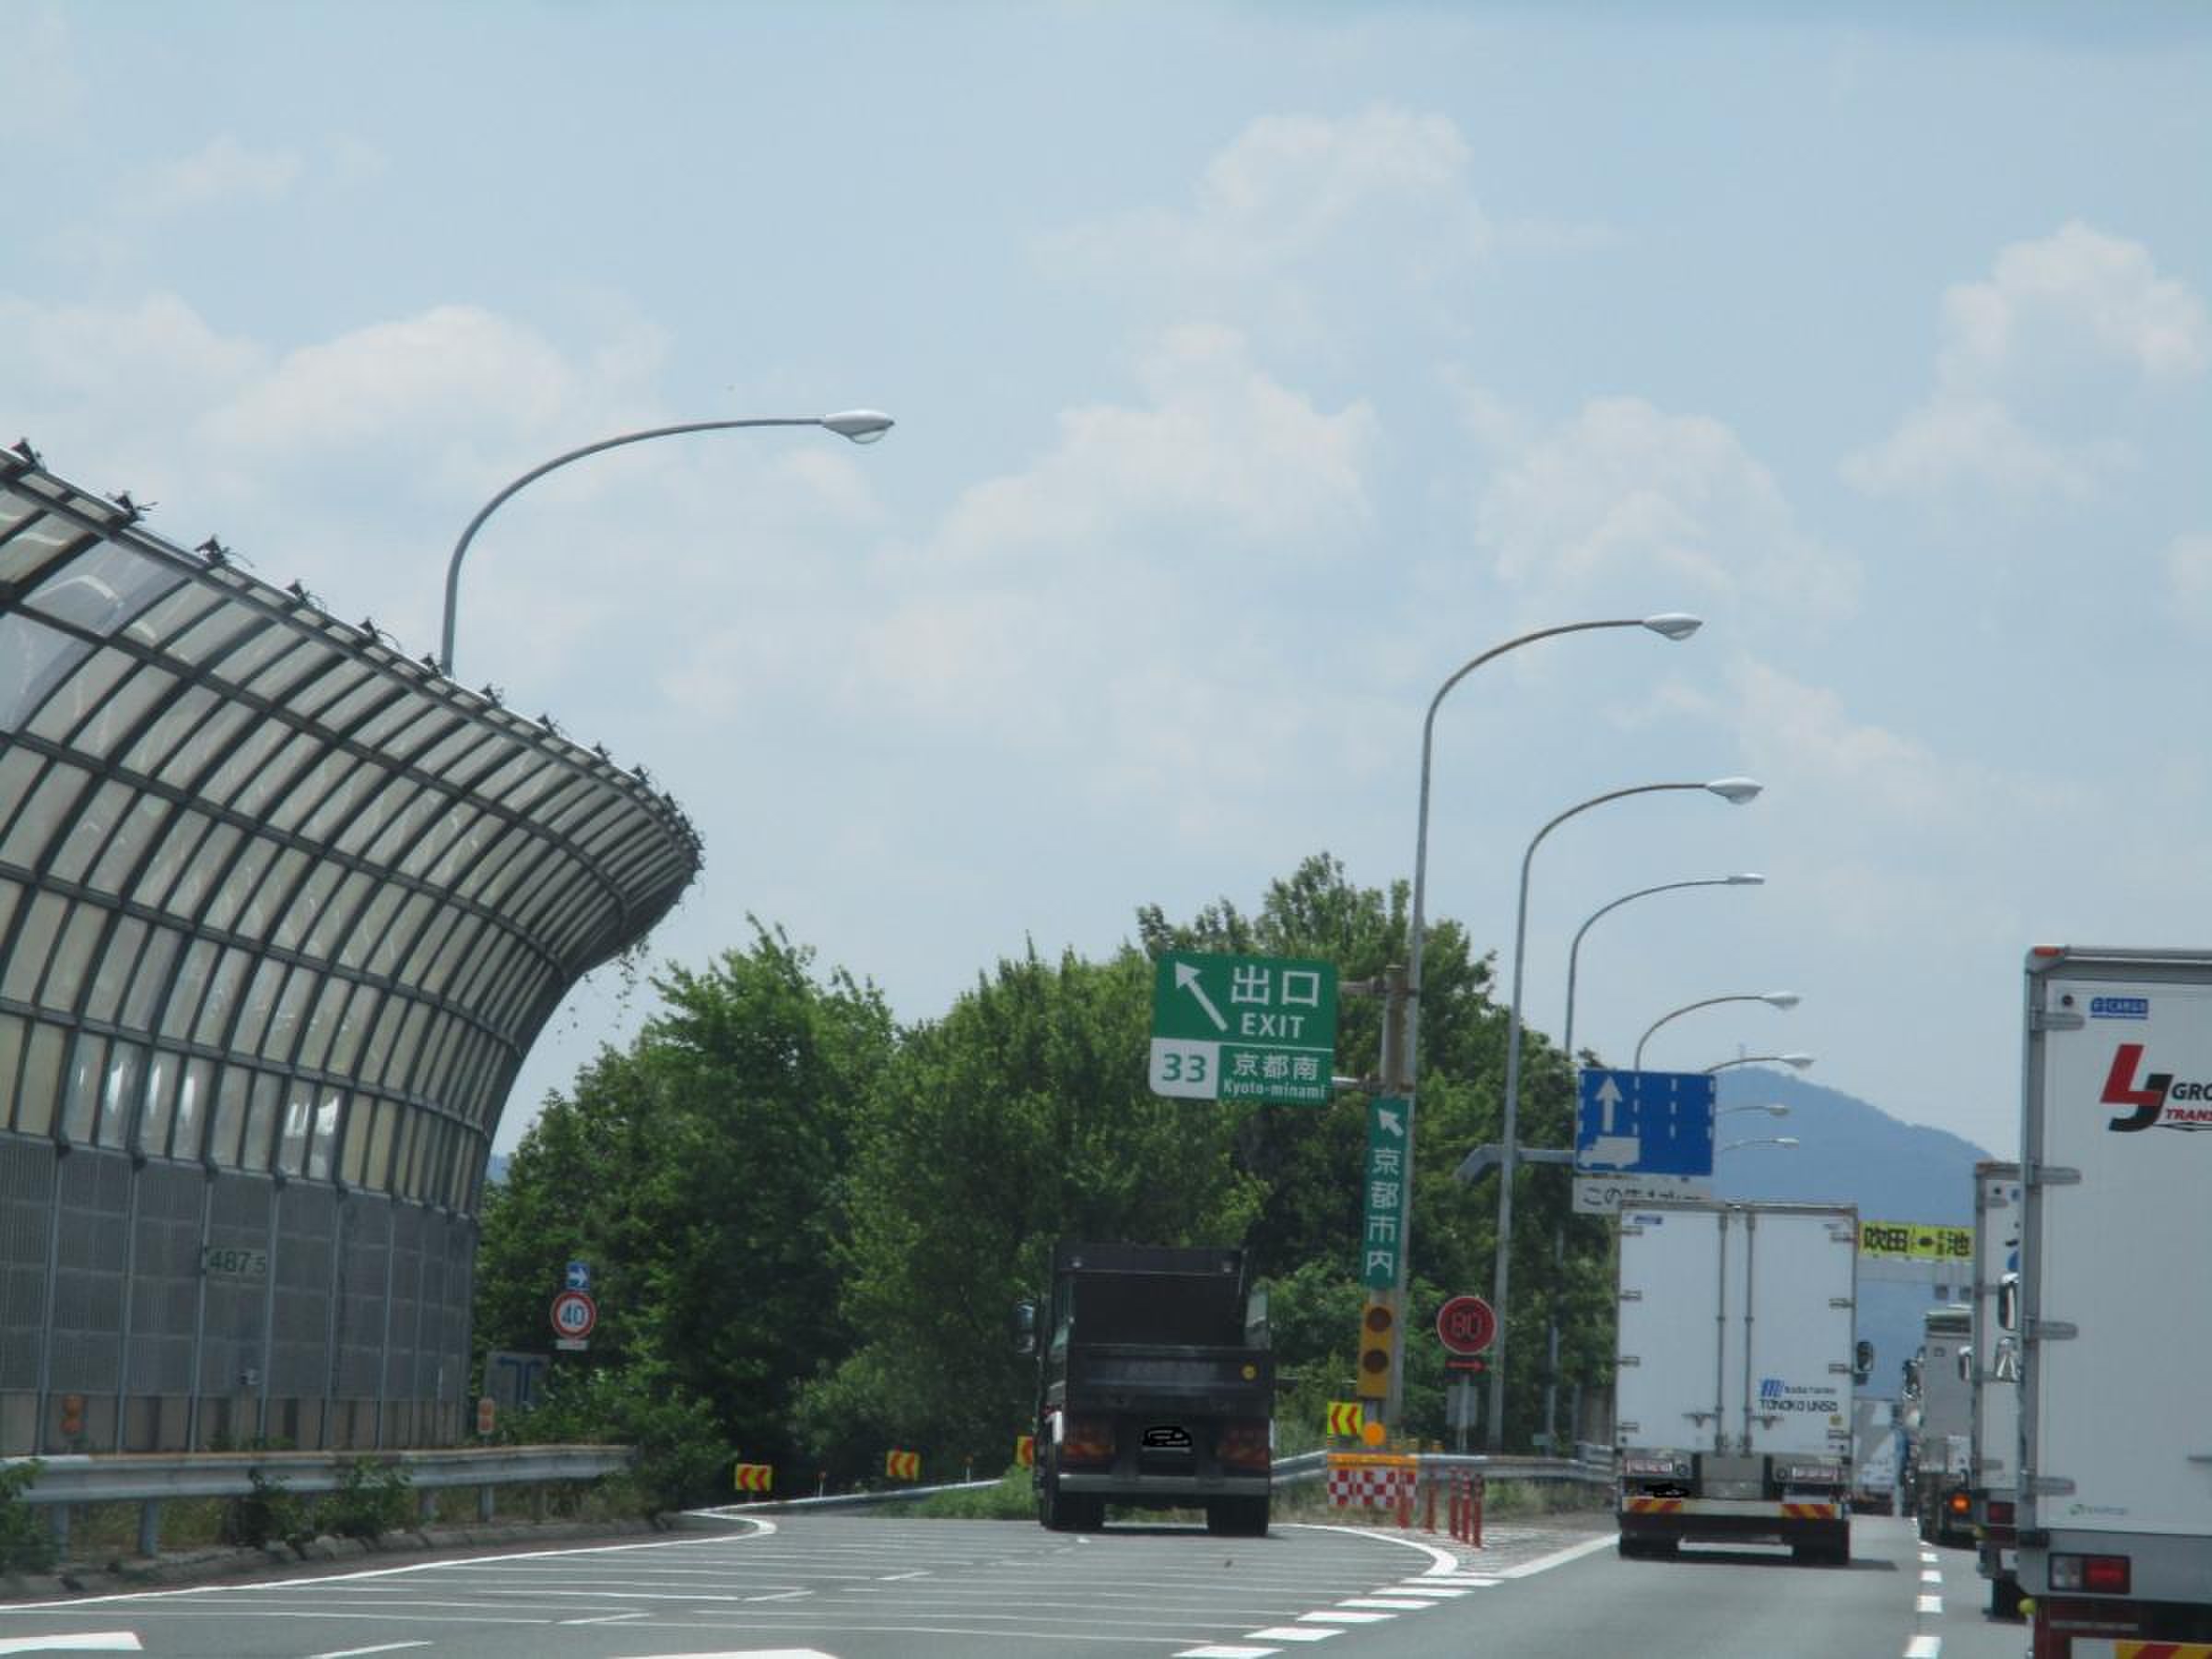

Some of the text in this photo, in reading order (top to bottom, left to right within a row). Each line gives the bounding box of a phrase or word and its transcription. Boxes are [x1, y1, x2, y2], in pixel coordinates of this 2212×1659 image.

[1230, 965, 1320, 1007] 出口
[1241, 1014, 1305, 1039] EXIT
[1161, 1053, 1206, 1082] 33
[1233, 1053, 1320, 1080] 京都南
[1223, 1078, 1325, 1100] Kyoto-minami
[1366, 1148, 1402, 1279] 京都市内
[561, 1303, 586, 1327] 40
